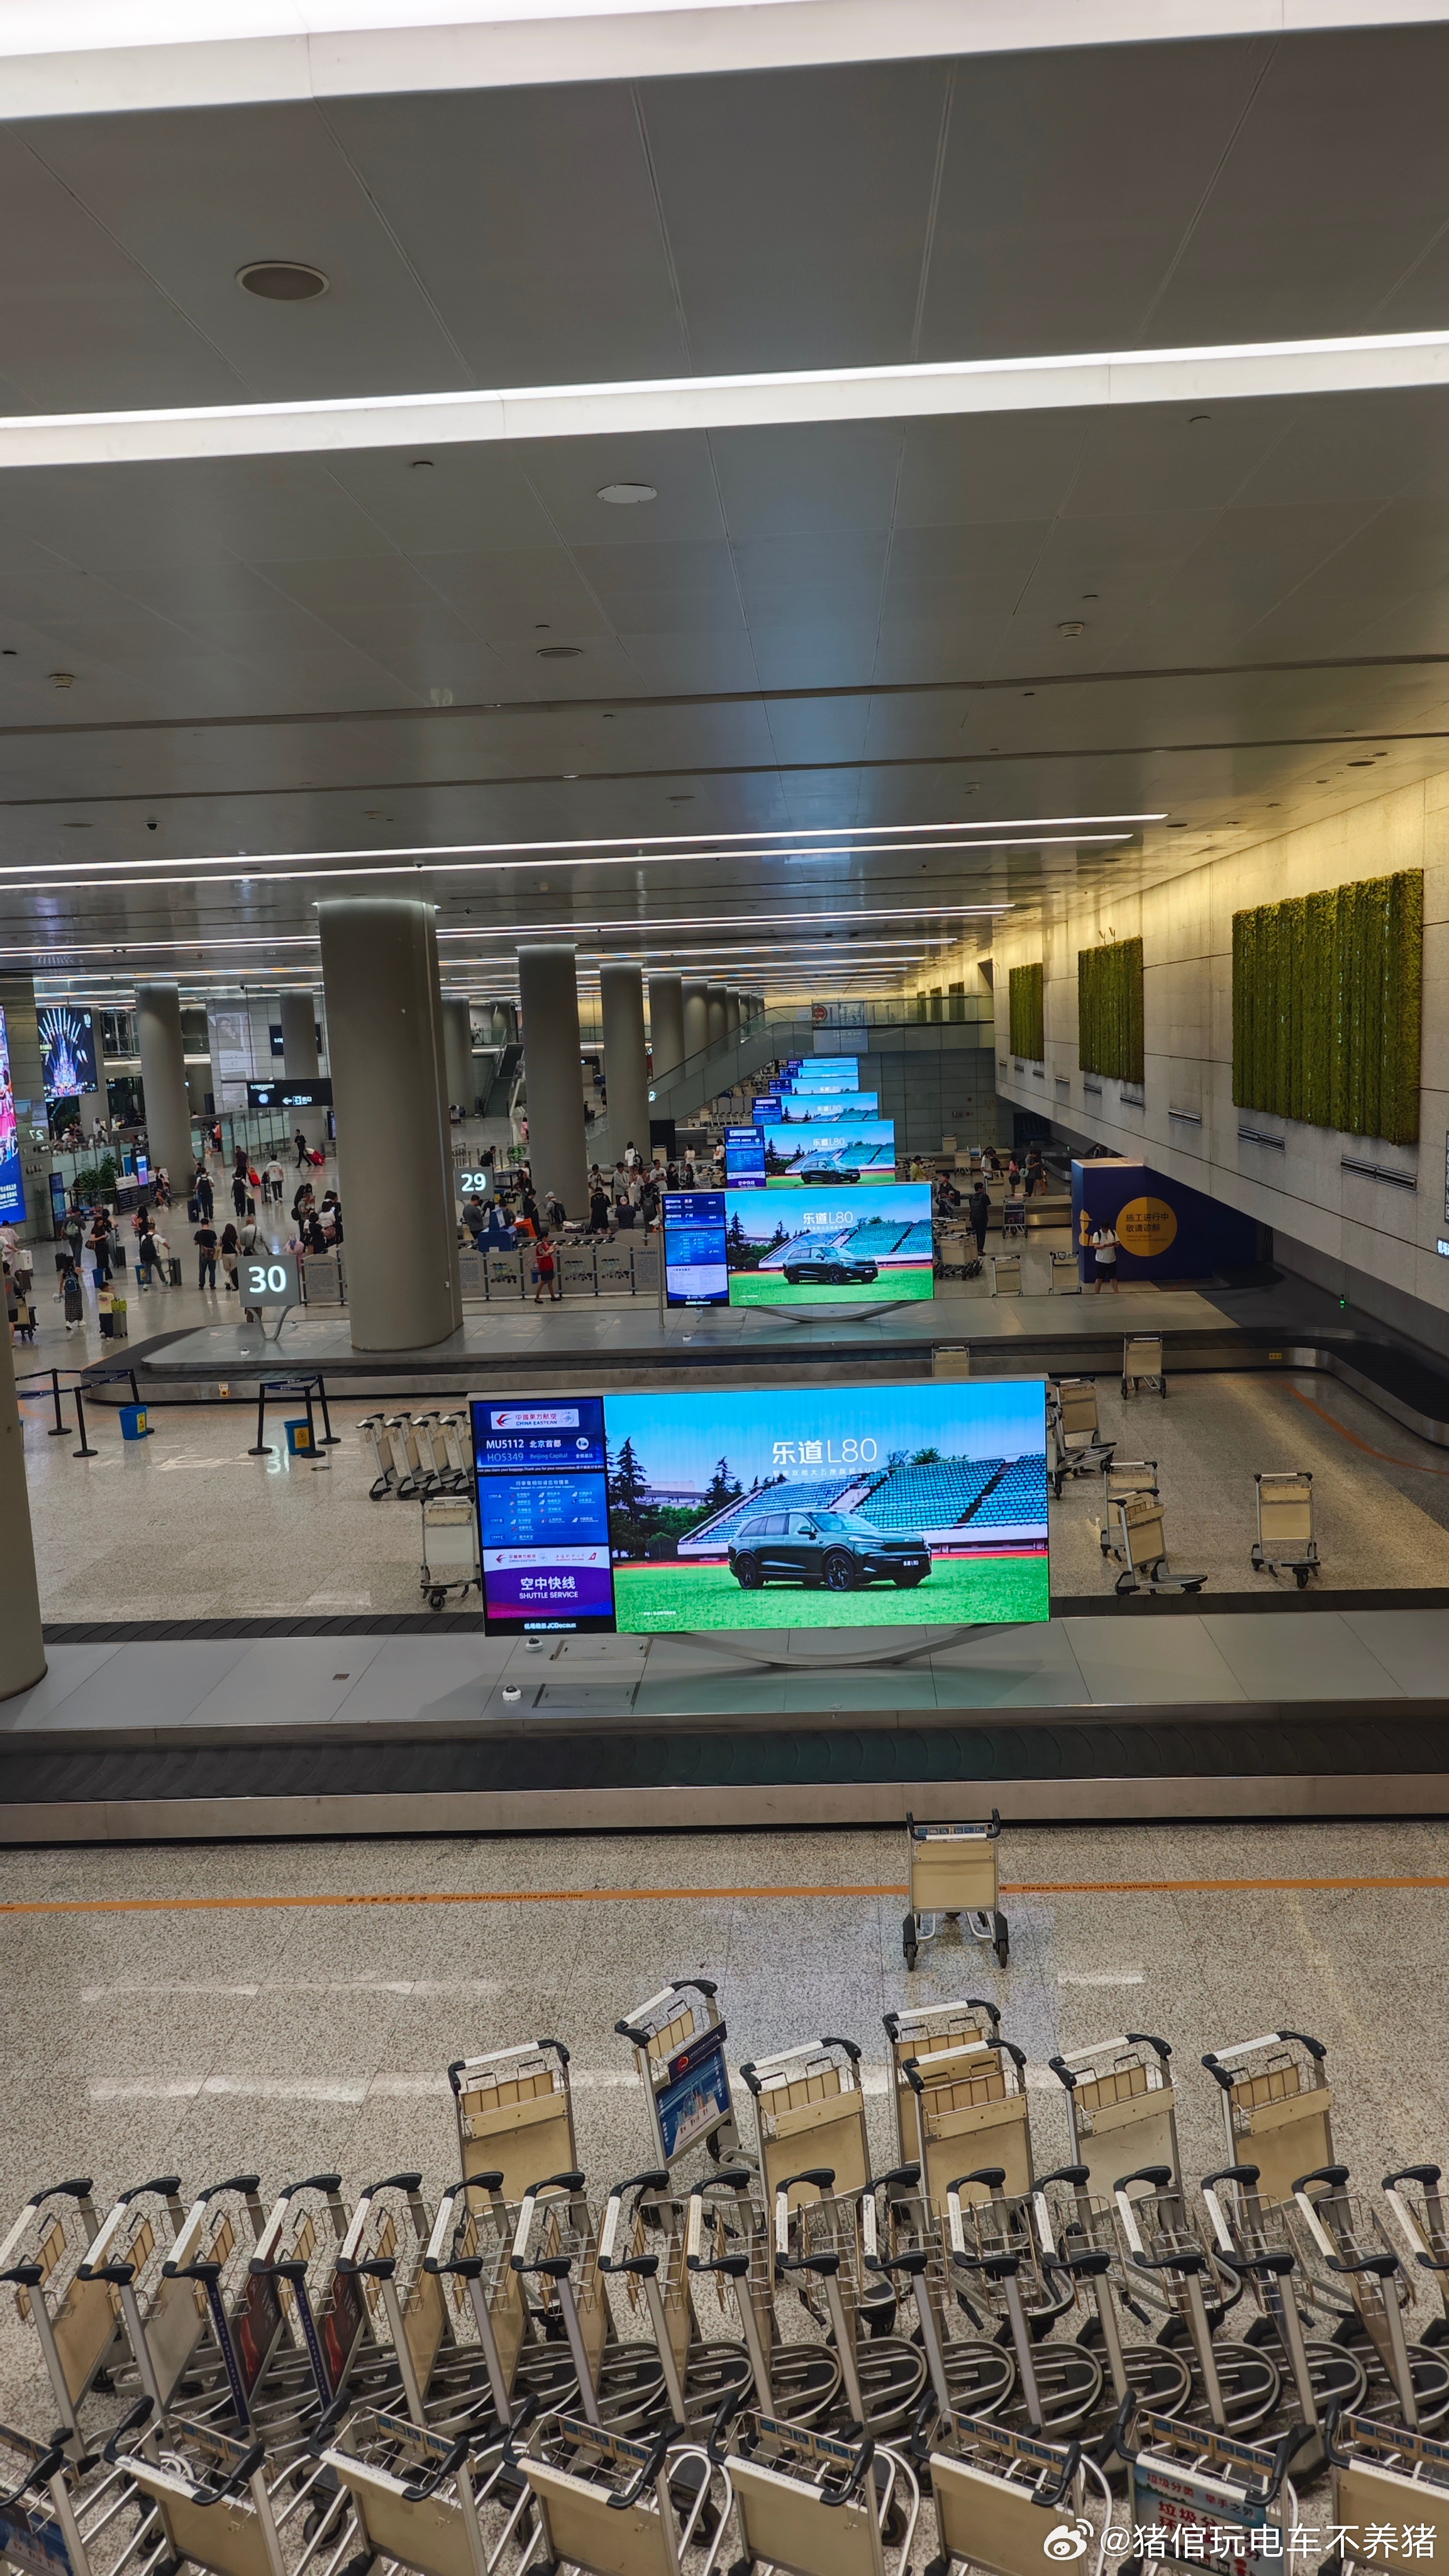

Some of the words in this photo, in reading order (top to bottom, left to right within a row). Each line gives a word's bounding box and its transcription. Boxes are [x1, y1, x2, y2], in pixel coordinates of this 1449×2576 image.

[813, 1138, 845, 1146] 乐道L80
[461, 1172, 487, 1192] 29
[803, 1211, 853, 1224] 乐道L80
[1126, 1213, 1169, 1222] 施工进行中
[1126, 1224, 1160, 1233] 敬请谅解
[248, 1265, 287, 1294] 30
[486, 1439, 525, 1449] MU5112
[530, 1439, 562, 1448] 北京首都
[772, 1438, 877, 1465] 乐道L80
[520, 1576, 576, 1591] 空中快线
[1147, 2472, 1195, 2498] 垃圾分类
[1205, 2493, 1255, 2518] 举手之劳
